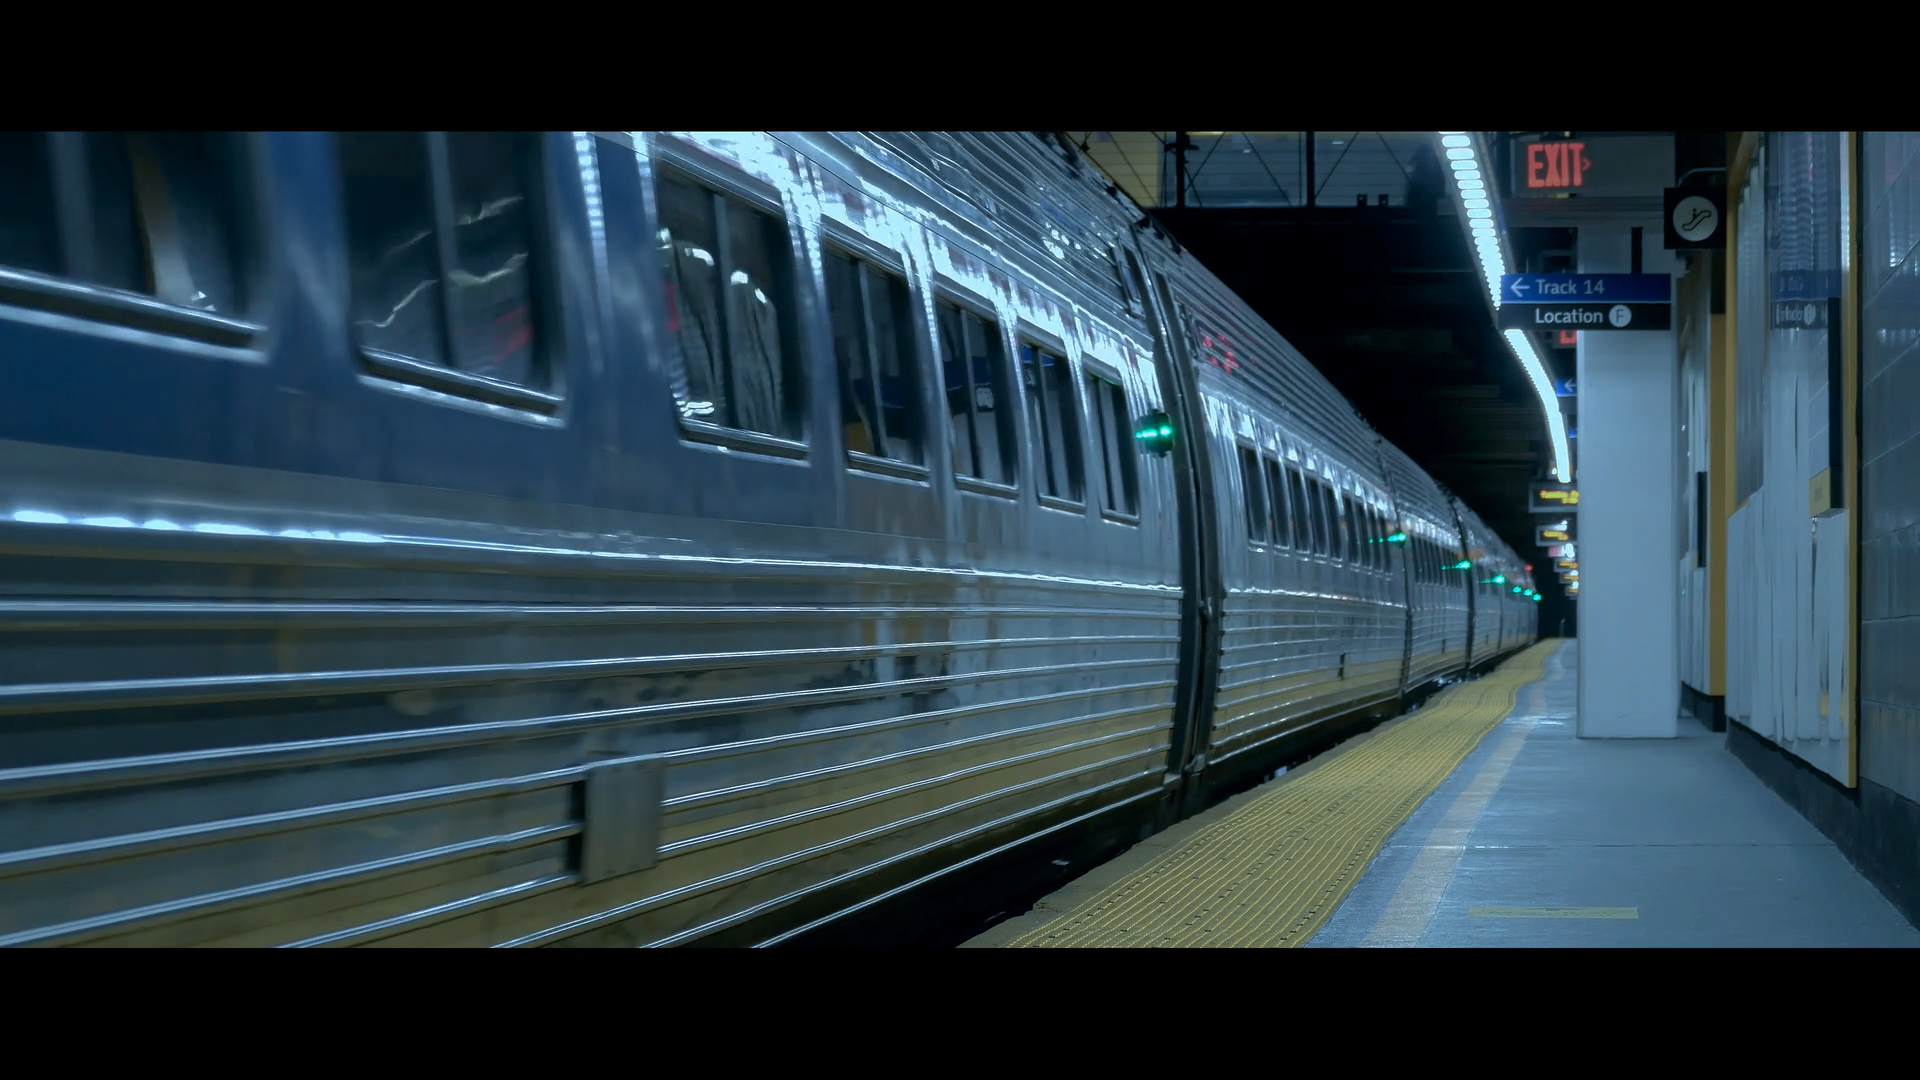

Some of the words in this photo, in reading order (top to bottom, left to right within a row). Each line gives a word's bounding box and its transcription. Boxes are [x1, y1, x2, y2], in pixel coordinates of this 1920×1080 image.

[1527, 143, 1585, 188] EXIT
[1535, 279, 1577, 295] Track
[1583, 279, 1605, 295] 14
[1535, 308, 1604, 324] Location
